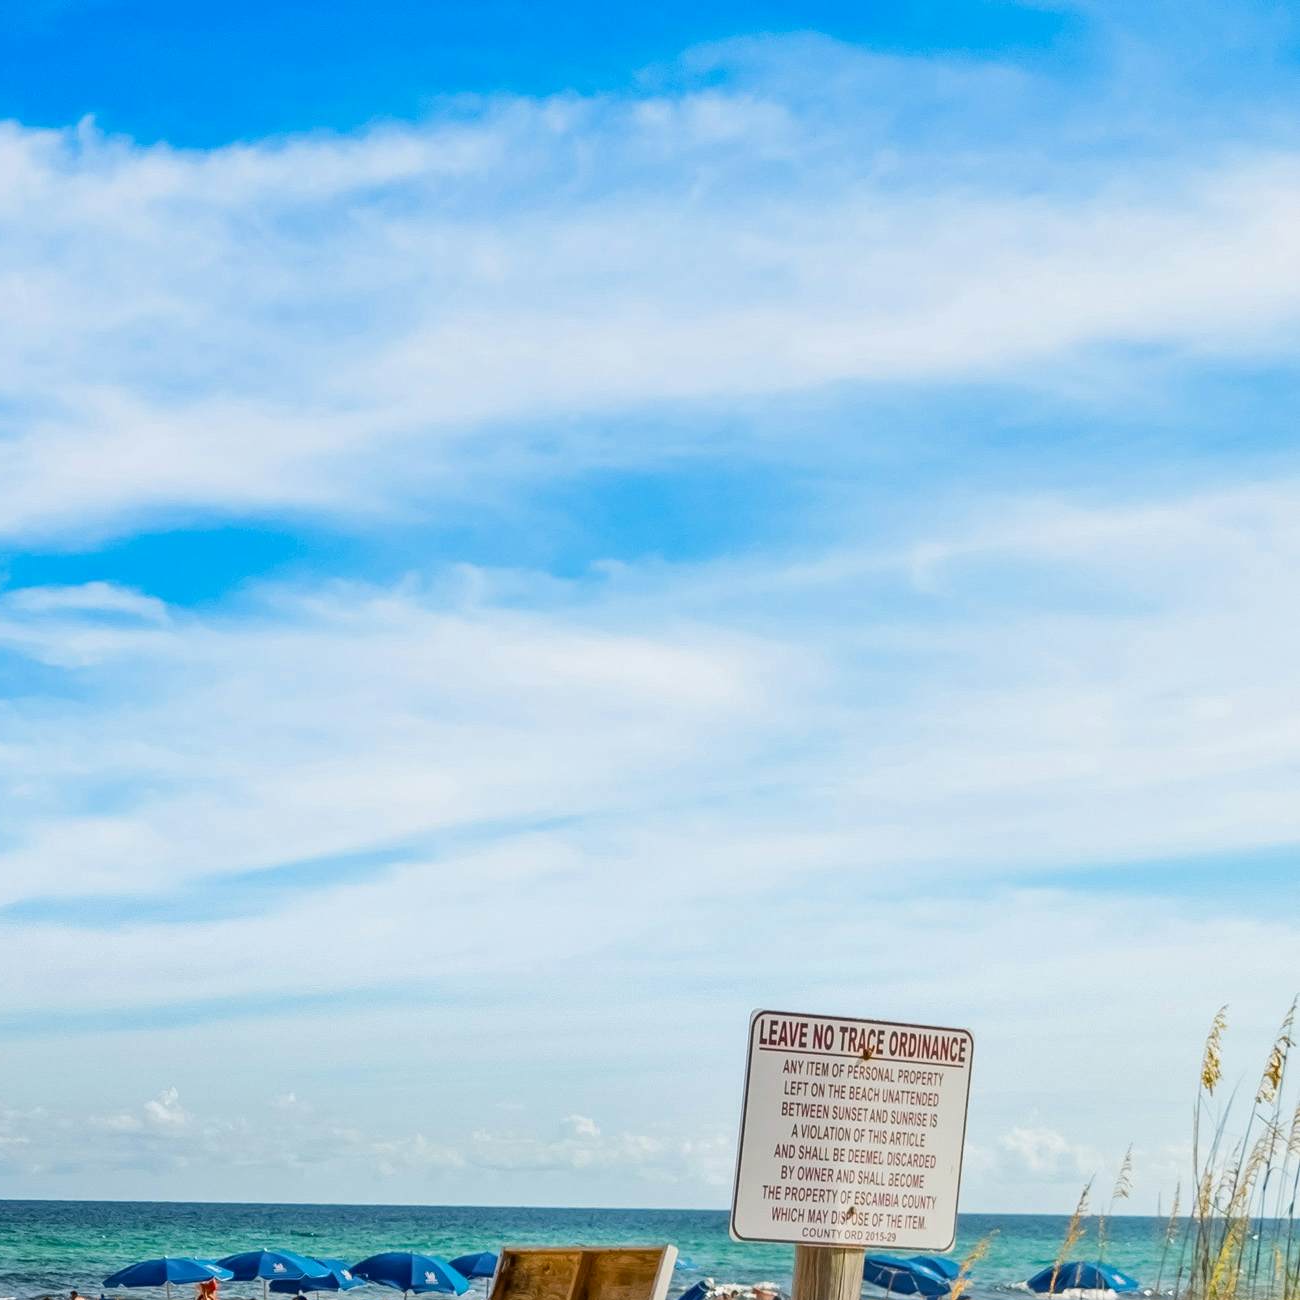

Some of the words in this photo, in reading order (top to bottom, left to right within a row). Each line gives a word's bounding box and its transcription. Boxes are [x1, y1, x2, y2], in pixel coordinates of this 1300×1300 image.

[759, 1019, 808, 1048] LEAVE
[812, 1024, 835, 1050] NO
[839, 1026, 885, 1055] TRACE
[889, 1031, 967, 1063] ORDINANCE
[782, 1059, 804, 1074] ANY
[806, 1061, 829, 1077] ITEM
[831, 1063, 845, 1078] OF
[847, 1065, 895, 1083] PERSONAL
[898, 1070, 944, 1087] PROPERTY
[784, 1081, 809, 1096] LEFT
[811, 1083, 826, 1097] ON
[828, 1084, 846, 1099] THE
[849, 1086, 881, 1103] BEACH
[882, 1089, 939, 1107] UNATTENDED
[781, 1101, 829, 1119] BETWEEN
[832, 1105, 868, 1122] SUNSET
[869, 1109, 888, 1124] AND
[890, 1110, 927, 1127] SUNRISE
[929, 1113, 938, 1128] IS
[791, 1123, 798, 1138] A
[801, 1125, 851, 1141] VIOLATION
[853, 1128, 865, 1142] OF
[869, 1129, 887, 1145] THIS
[889, 1131, 926, 1147] ARTICLE
[774, 1143, 795, 1159] AND
[798, 1145, 830, 1161] SHALL
[833, 1147, 845, 1162] BE
[887, 1152, 937, 1169] DISCARDED
[780, 1165, 795, 1180] BY
[797, 1166, 834, 1182] OWNER
[836, 1169, 855, 1184] AND
[857, 1171, 885, 1186] SHALL
[888, 1173, 925, 1189] BECOME
[762, 1185, 782, 1200] THE
[784, 1186, 838, 1204] PROPERTY
[840, 1190, 852, 1205] OF
[854, 1191, 899, 1207] ESCAMBIA
[901, 1195, 937, 1209] COUNTY
[771, 1207, 805, 1223] WHICH
[807, 1209, 829, 1224] MAY
[831, 1210, 869, 1227] DISPOSE
[872, 1214, 884, 1227] OF
[887, 1214, 903, 1229] THE
[904, 1215, 927, 1230] ITEM.
[802, 1227, 842, 1239] COUNTY
[844, 1230, 863, 1240] ORD
[866, 1231, 897, 1242] 2015-29
